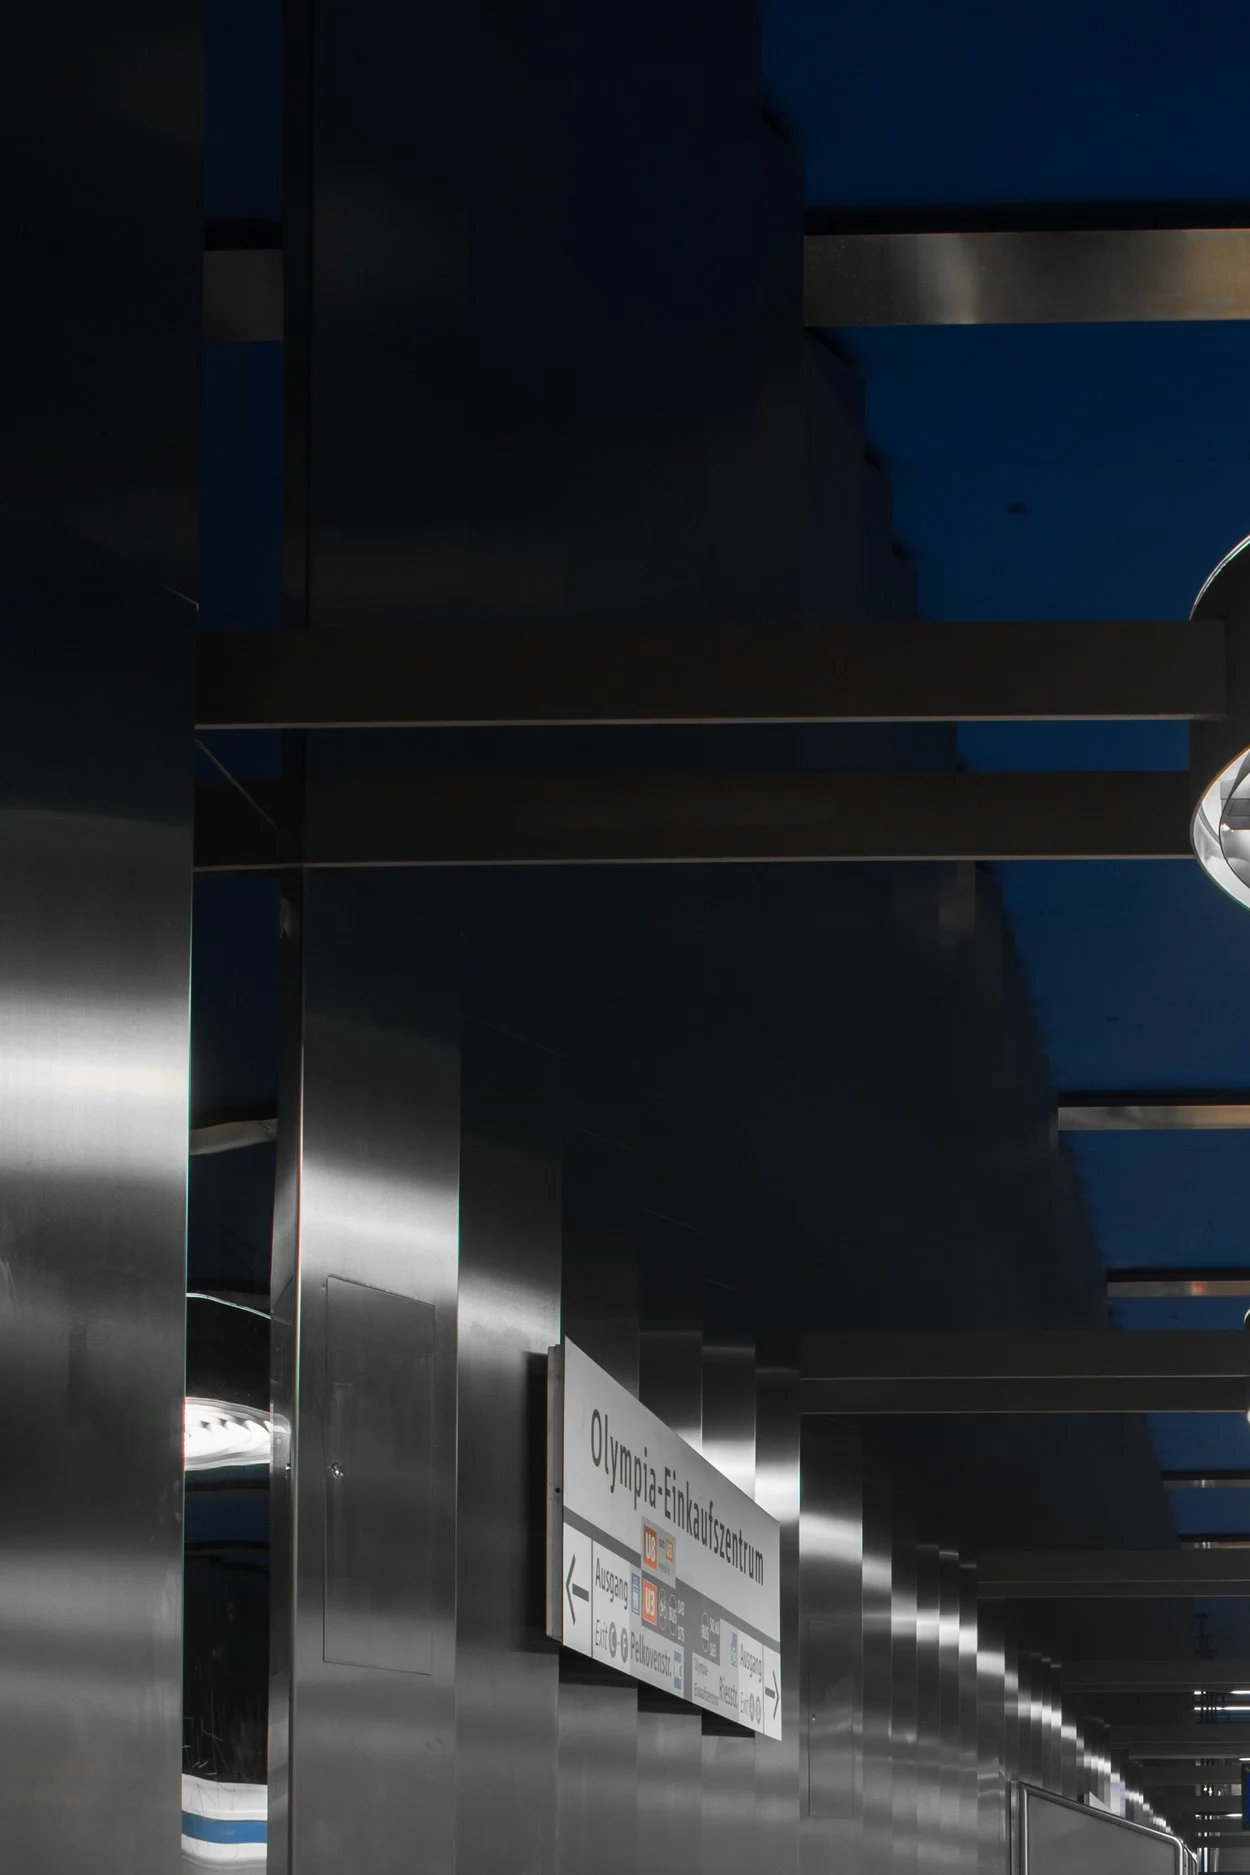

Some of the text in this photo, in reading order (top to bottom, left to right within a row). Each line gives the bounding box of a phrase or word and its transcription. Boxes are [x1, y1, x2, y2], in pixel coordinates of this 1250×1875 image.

[591, 1408, 764, 1587] Olympia-Einkaufszentrum
[645, 1532, 656, 1563] U8
[595, 1557, 629, 1610] Ausgang
[645, 1586, 656, 1616] U3
[595, 1619, 608, 1650] Exit
[631, 1631, 672, 1677] Pelkovenstr.
[740, 1643, 762, 1683] Ausgang
